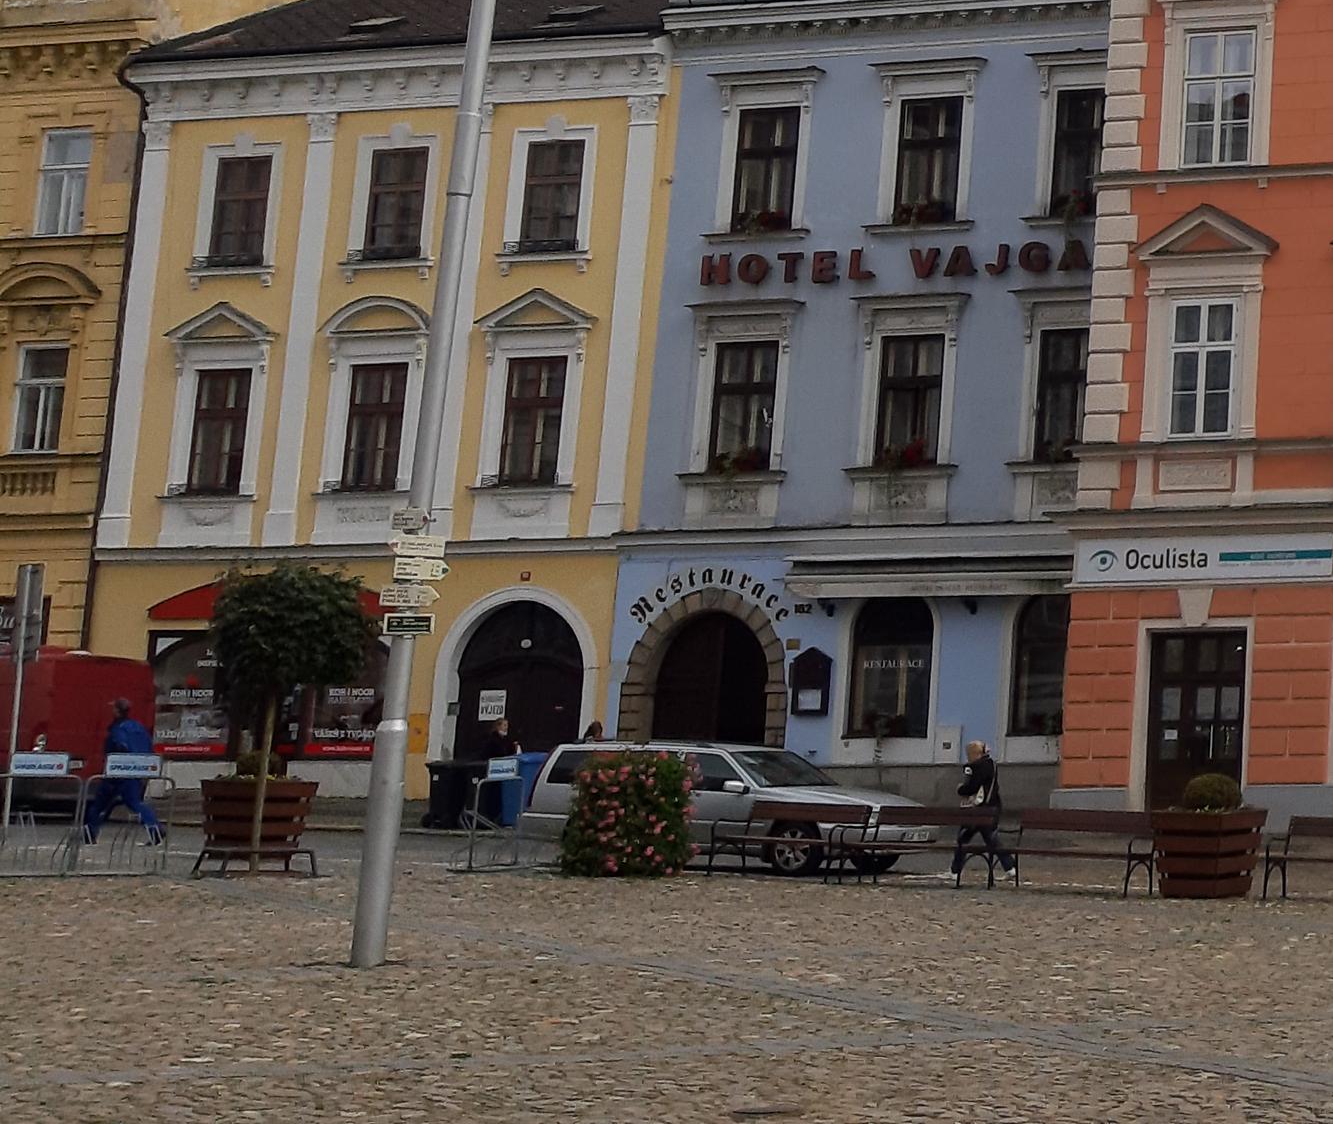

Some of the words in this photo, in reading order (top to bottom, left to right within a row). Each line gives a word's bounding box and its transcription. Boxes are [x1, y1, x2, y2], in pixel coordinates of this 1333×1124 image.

[700, 246, 877, 287] HOTEL
[1124, 547, 1209, 570] Oculista
[629, 567, 789, 624] Restaurace
